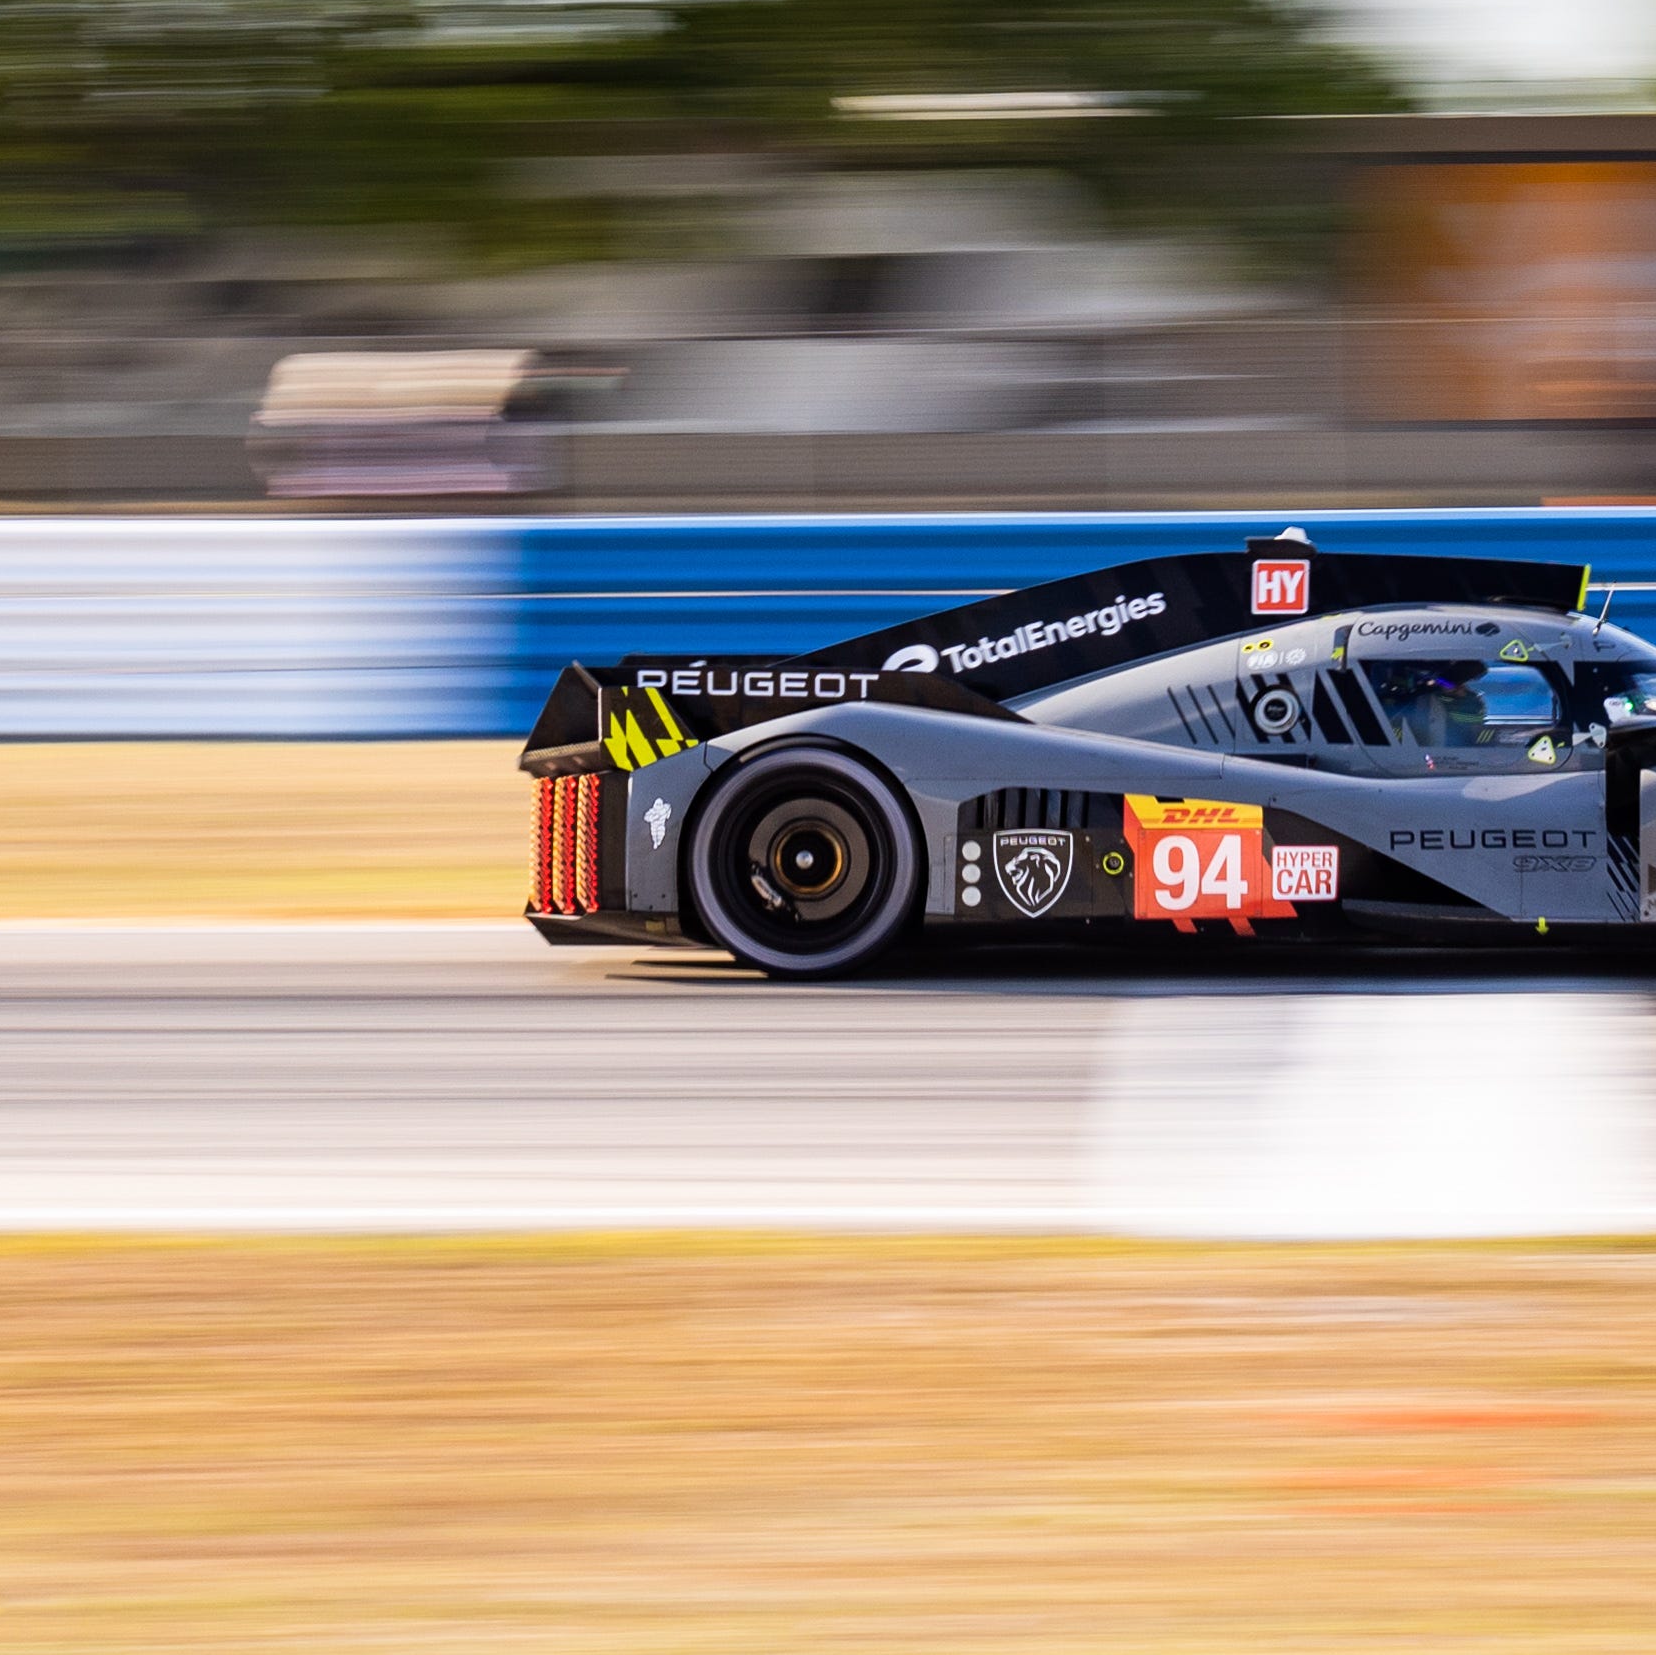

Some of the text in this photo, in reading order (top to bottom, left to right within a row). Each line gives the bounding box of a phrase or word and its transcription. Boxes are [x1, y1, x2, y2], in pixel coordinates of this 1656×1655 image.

[1257, 570, 1305, 604] HY
[941, 591, 1166, 674] TotalEnergies
[1357, 620, 1474, 643] Capgemini
[1162, 808, 1240, 824] DHL
[1000, 835, 1066, 847] PEUGEOT
[1389, 829, 1597, 851] PEUGEOT
[1276, 851, 1333, 868] HYPER
[1152, 834, 1249, 911] 94
[1276, 869, 1333, 895] CAR
